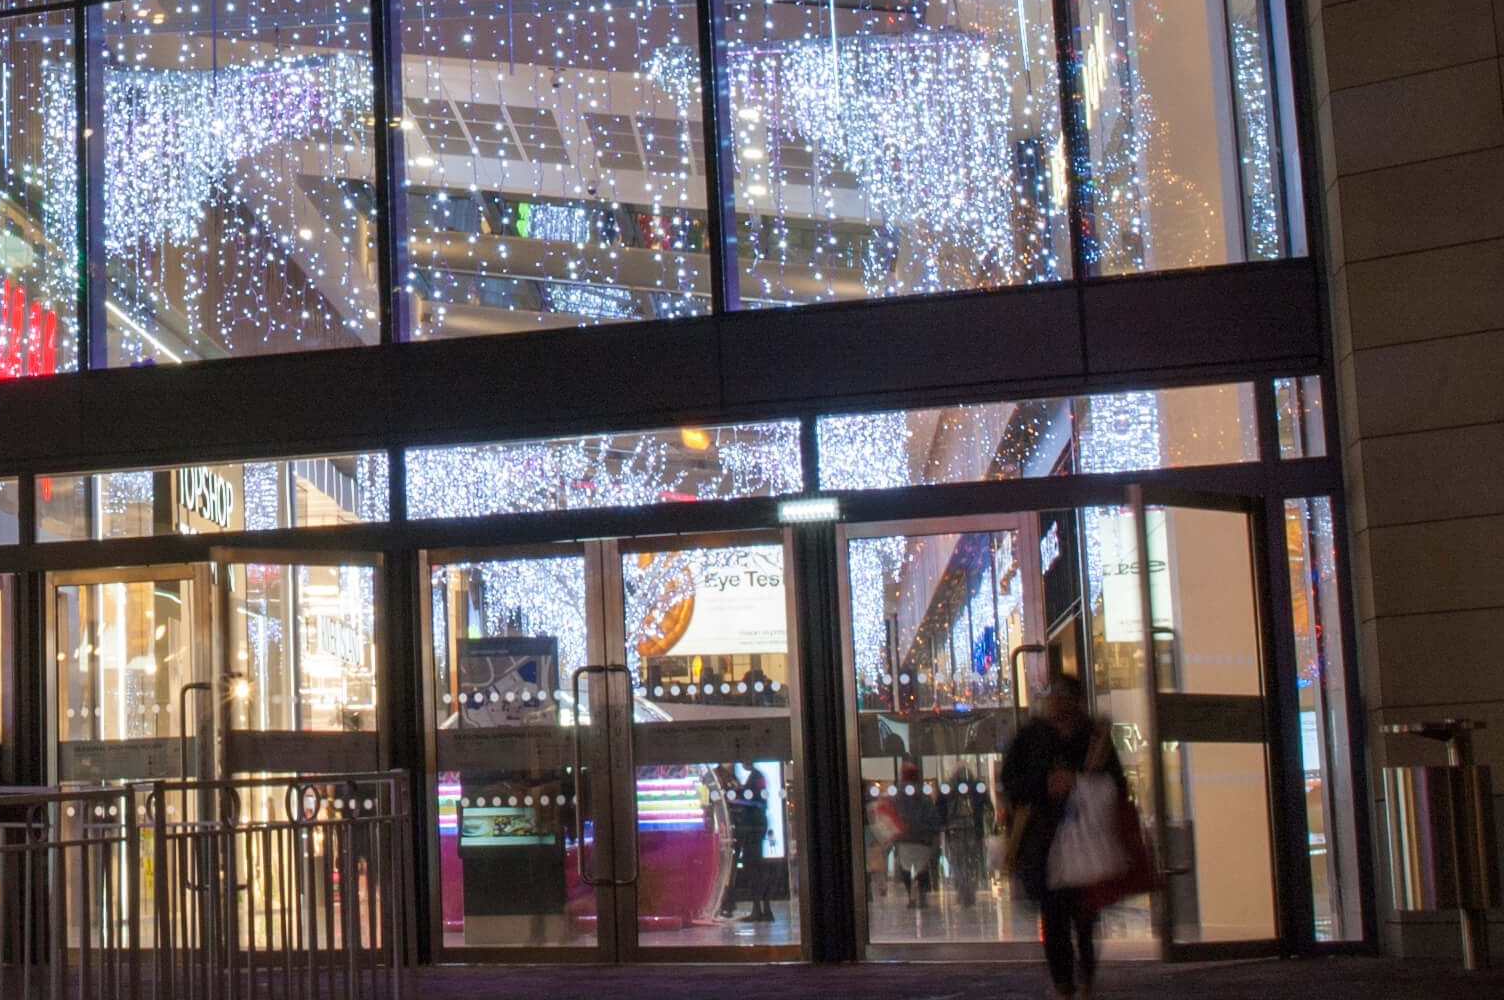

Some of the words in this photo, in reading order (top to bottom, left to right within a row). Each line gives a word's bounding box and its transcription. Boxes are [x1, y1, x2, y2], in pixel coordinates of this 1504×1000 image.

[179, 466, 234, 529] TOPSHOP
[704, 571, 741, 592] Eye
[744, 570, 782, 588] Tes
